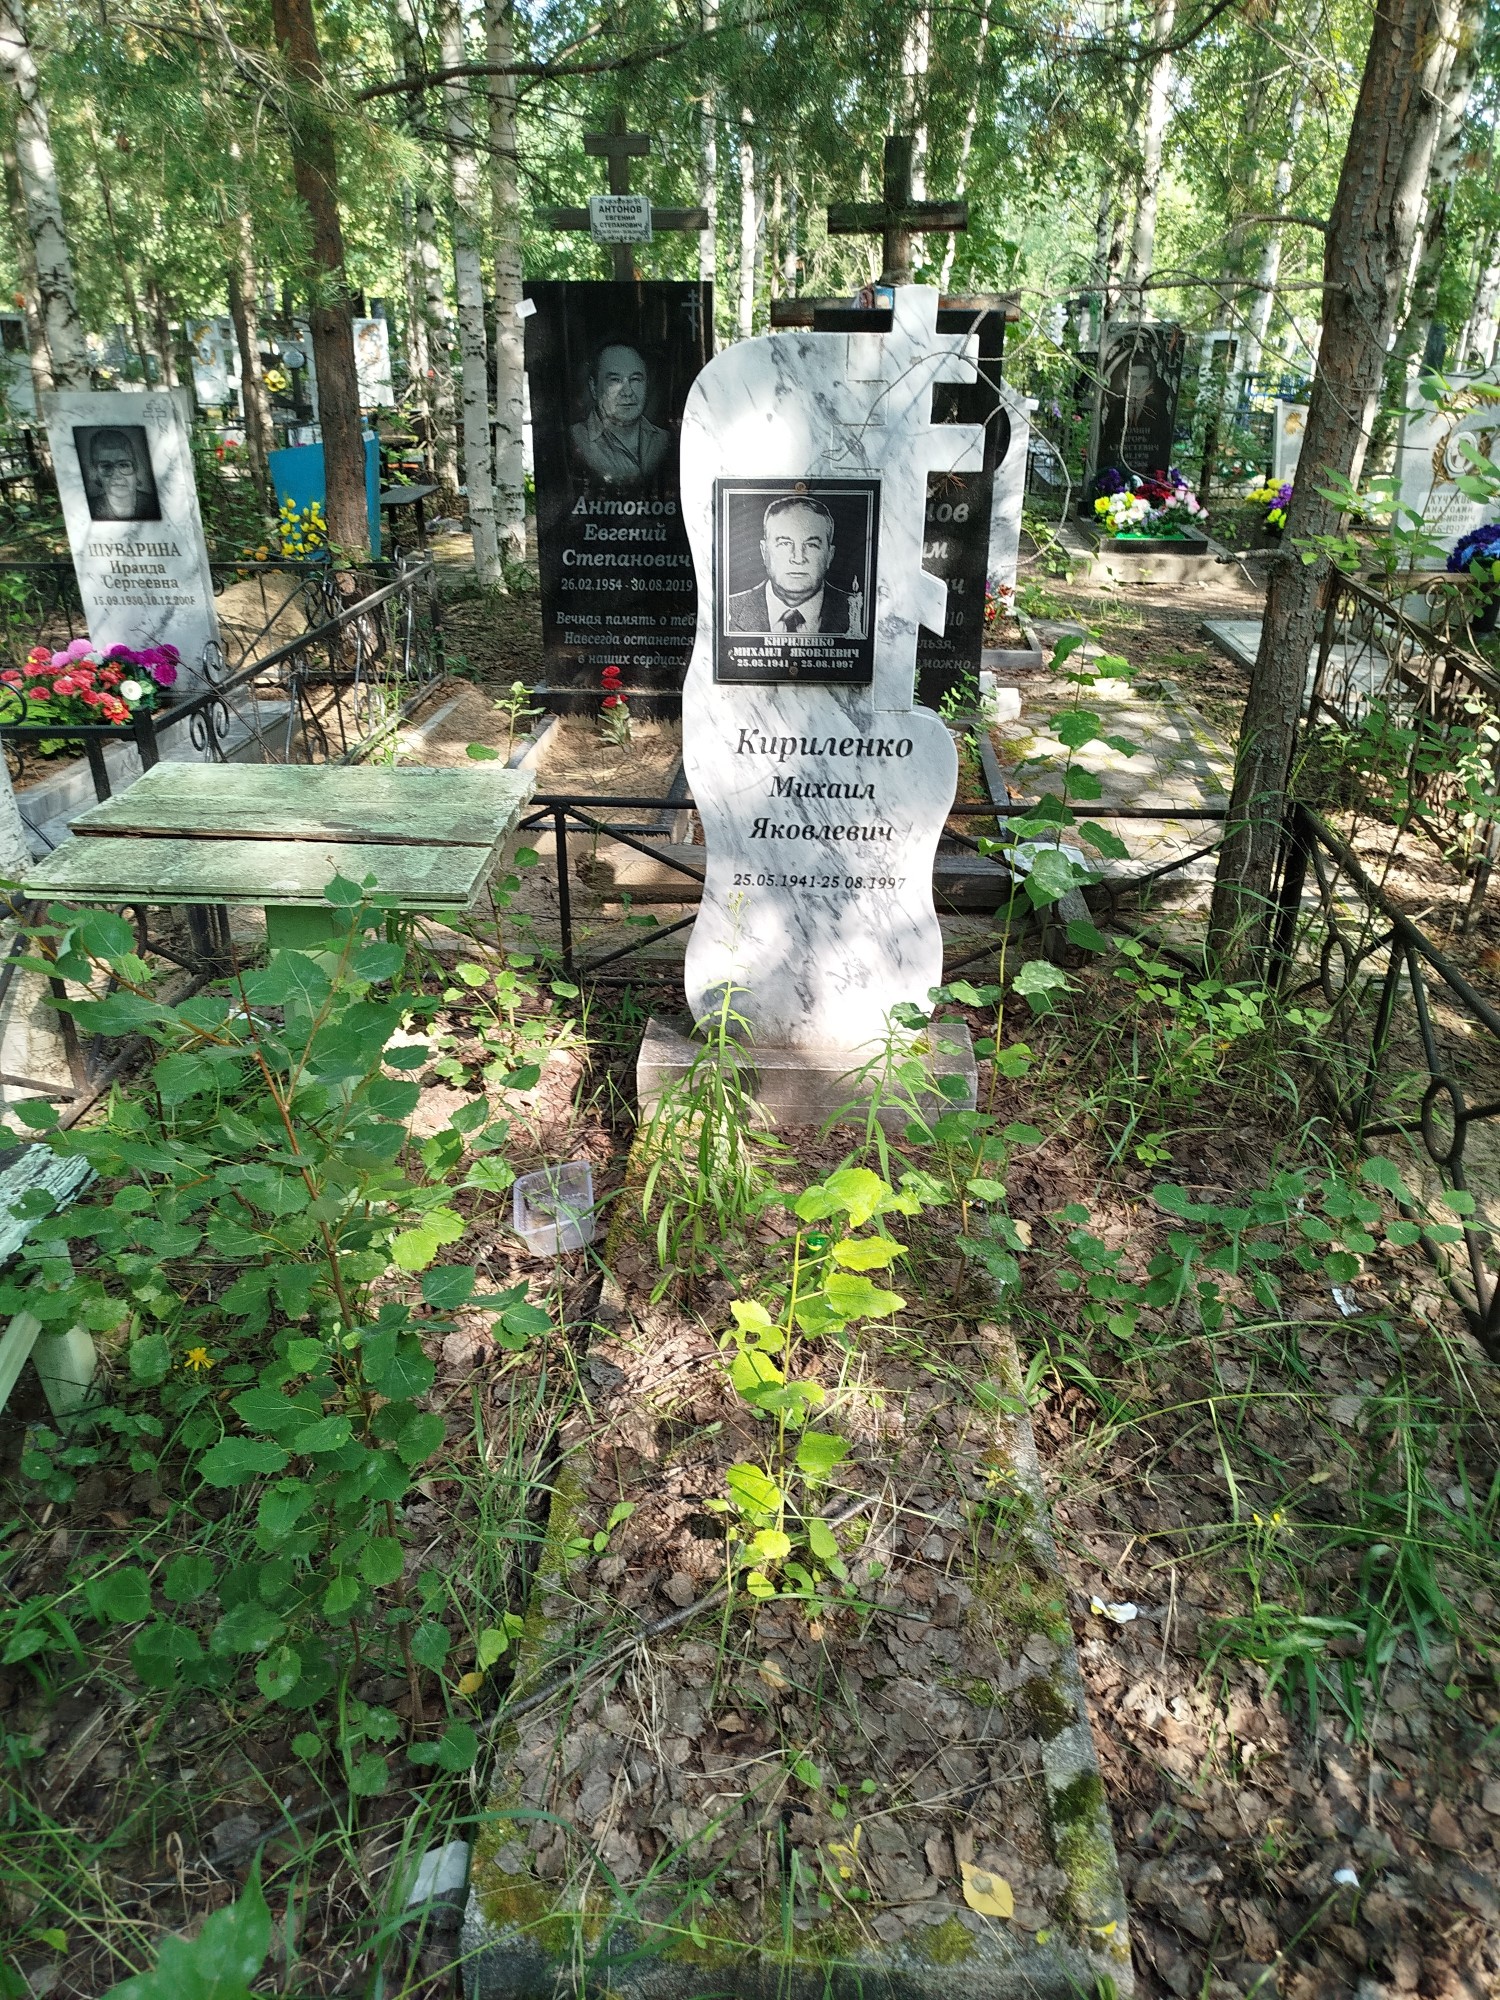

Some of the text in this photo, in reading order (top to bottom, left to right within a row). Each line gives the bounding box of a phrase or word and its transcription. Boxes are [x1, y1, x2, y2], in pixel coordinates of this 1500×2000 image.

[571, 495, 677, 516] Антонов
[1427, 506, 1473, 514] АНАОЛИЙ
[583, 522, 667, 541] Евгений
[88, 542, 182, 557] ШУВАРИНА
[562, 549, 692, 568] Степанович
[110, 560, 166, 576] Ираида
[101, 574, 180, 592] Сергеевна
[561, 578, 622, 591] 26.02.1954
[631, 578, 693, 592] 30.08.2019
[556, 611, 697, 627] Вечная память о теб
[564, 630, 695, 646] Навсегда останется
[764, 637, 835, 647] КИРИЛЕНКО
[577, 651, 687, 669] в наших сердцах.
[733, 647, 860, 658] МИХАИЛ ЯКОВЛЕВИЧ
[737, 659, 854, 669] 25.05.1941 25.08.1997
[737, 728, 914, 762] Кириленко
[768, 776, 876, 799] Михаил
[749, 817, 893, 841] Яковлевич
